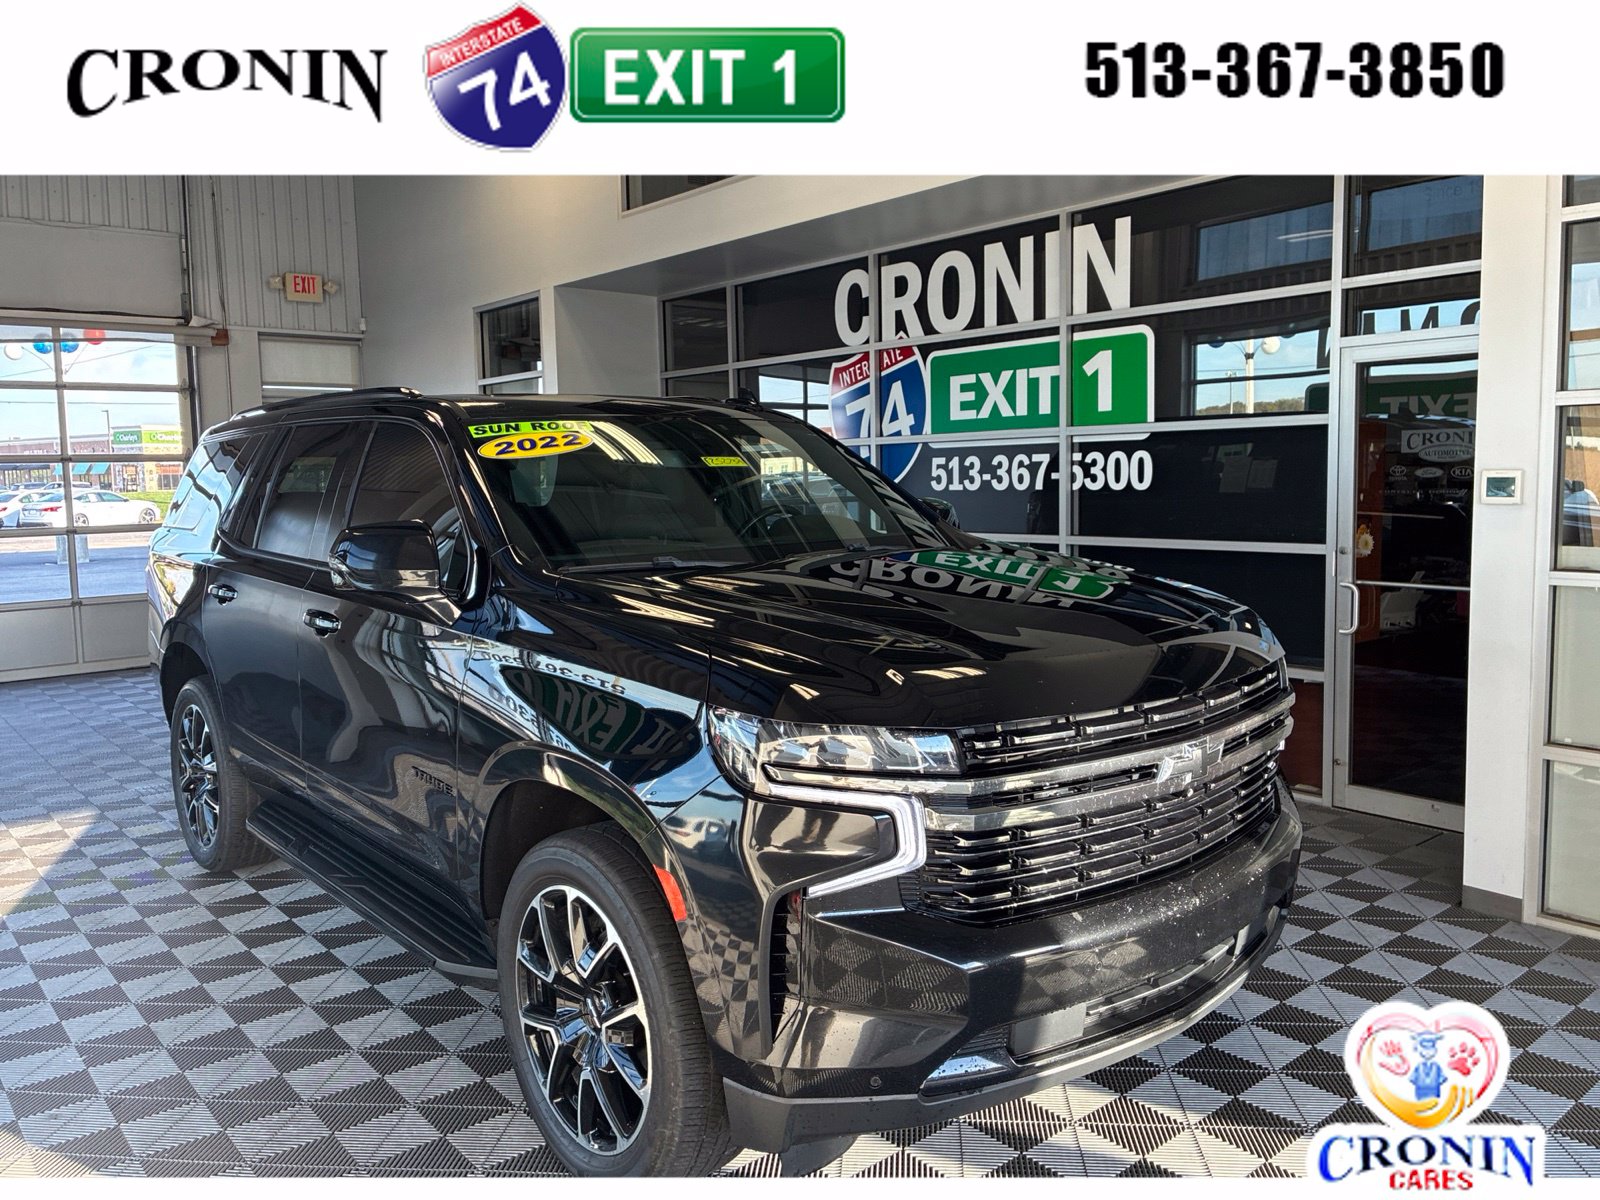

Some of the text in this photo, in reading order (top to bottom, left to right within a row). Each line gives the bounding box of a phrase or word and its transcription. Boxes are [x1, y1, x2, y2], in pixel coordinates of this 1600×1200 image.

[293, 274, 316, 295] EXIT
[834, 216, 1131, 346] CRONIN
[838, 347, 904, 388] INTERATE
[949, 350, 1113, 421] EXIT 1
[474, 423, 520, 436] SUN
[494, 434, 583, 455] 2022
[1406, 431, 1474, 450] CRONI
[930, 450, 1154, 491] 513-367-5300
